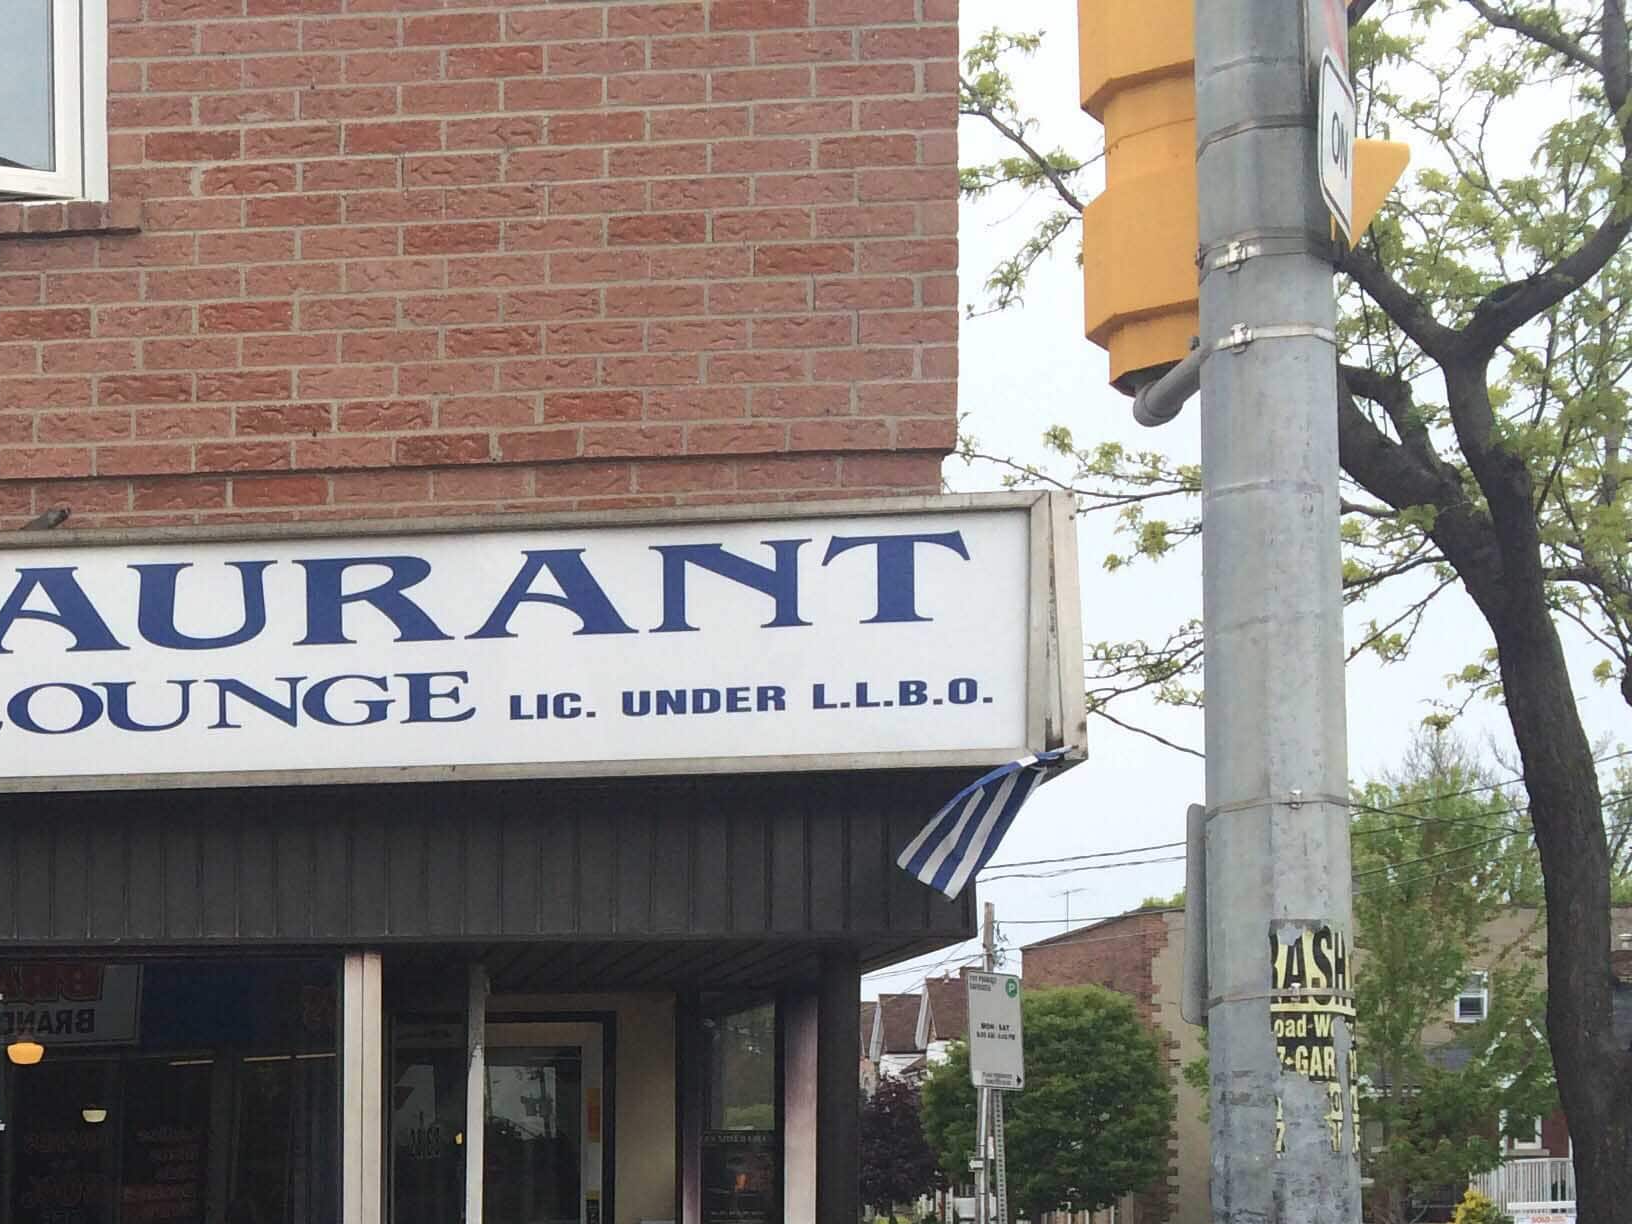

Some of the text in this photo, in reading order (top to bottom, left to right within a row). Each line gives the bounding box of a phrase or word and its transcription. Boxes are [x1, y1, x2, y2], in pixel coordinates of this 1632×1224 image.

[509, 691, 596, 722] LIC.
[622, 685, 787, 718] UNDER
[812, 678, 994, 711] L.L.B.O.
